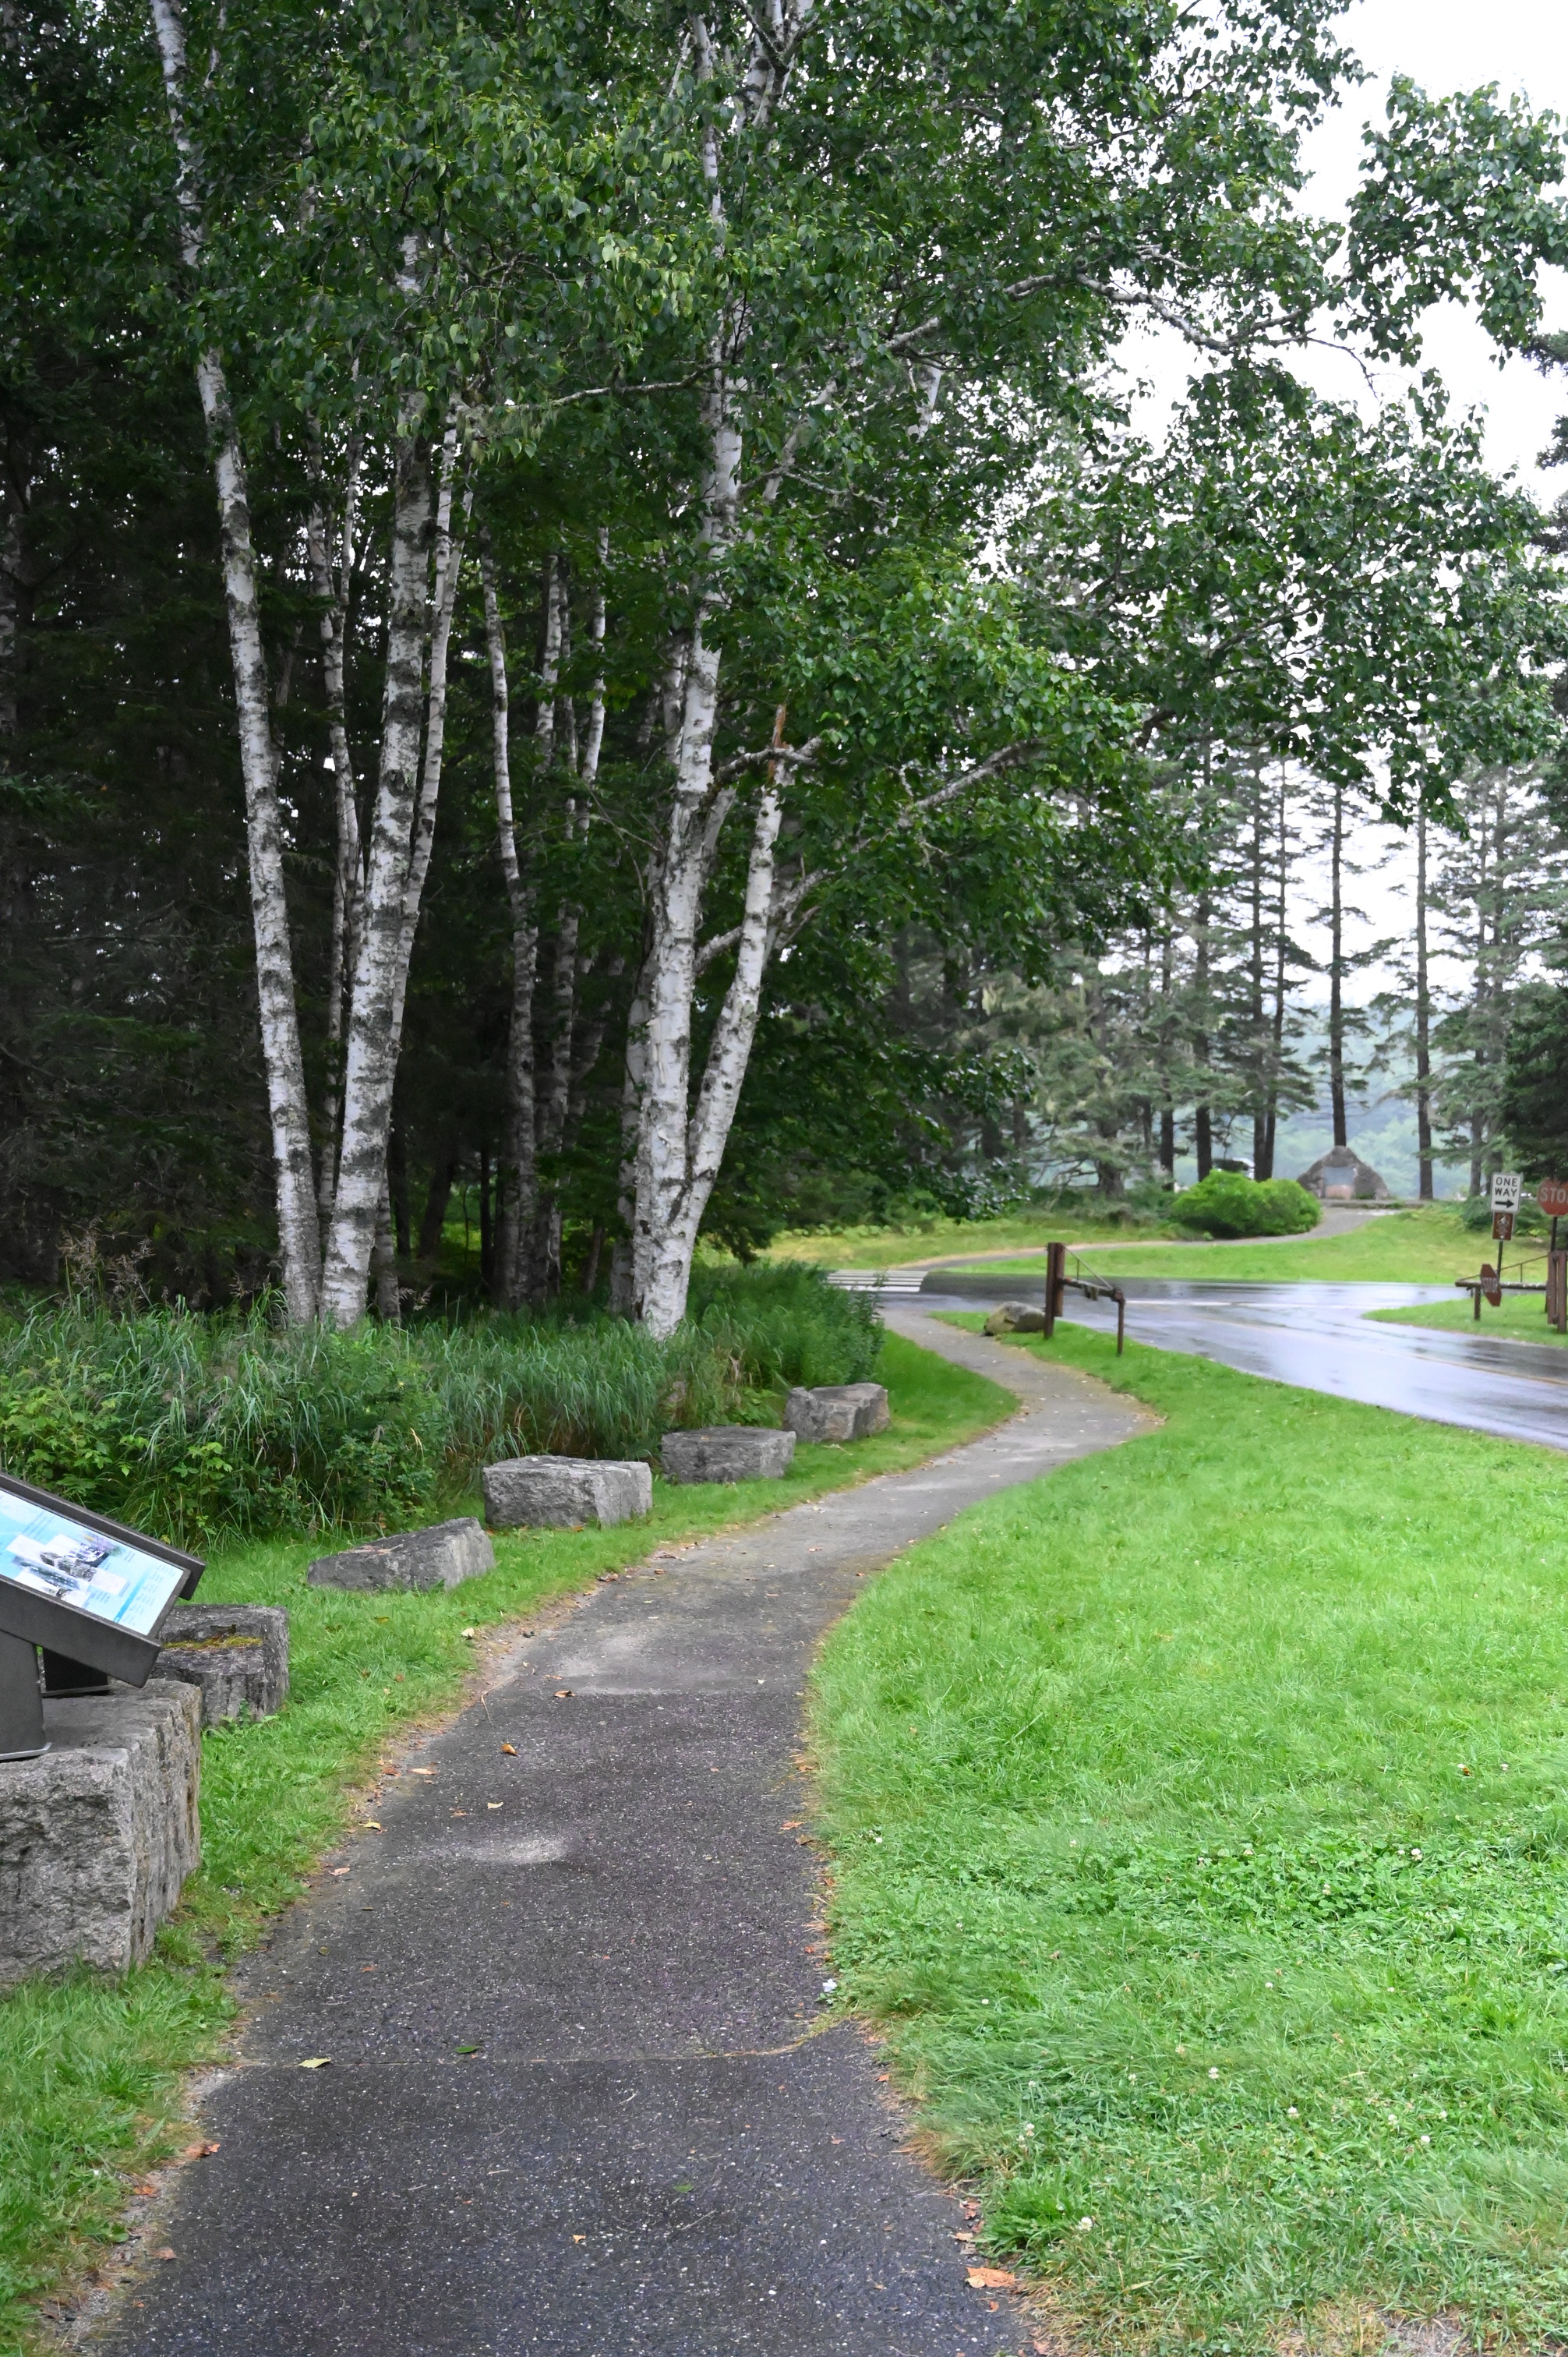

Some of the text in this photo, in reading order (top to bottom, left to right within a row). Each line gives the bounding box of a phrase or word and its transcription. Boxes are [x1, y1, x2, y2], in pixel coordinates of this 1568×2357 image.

[1496, 1177, 1517, 1187] ONE
[1495, 1187, 1517, 1197] WAY
[1539, 1187, 1568, 1203] STO
